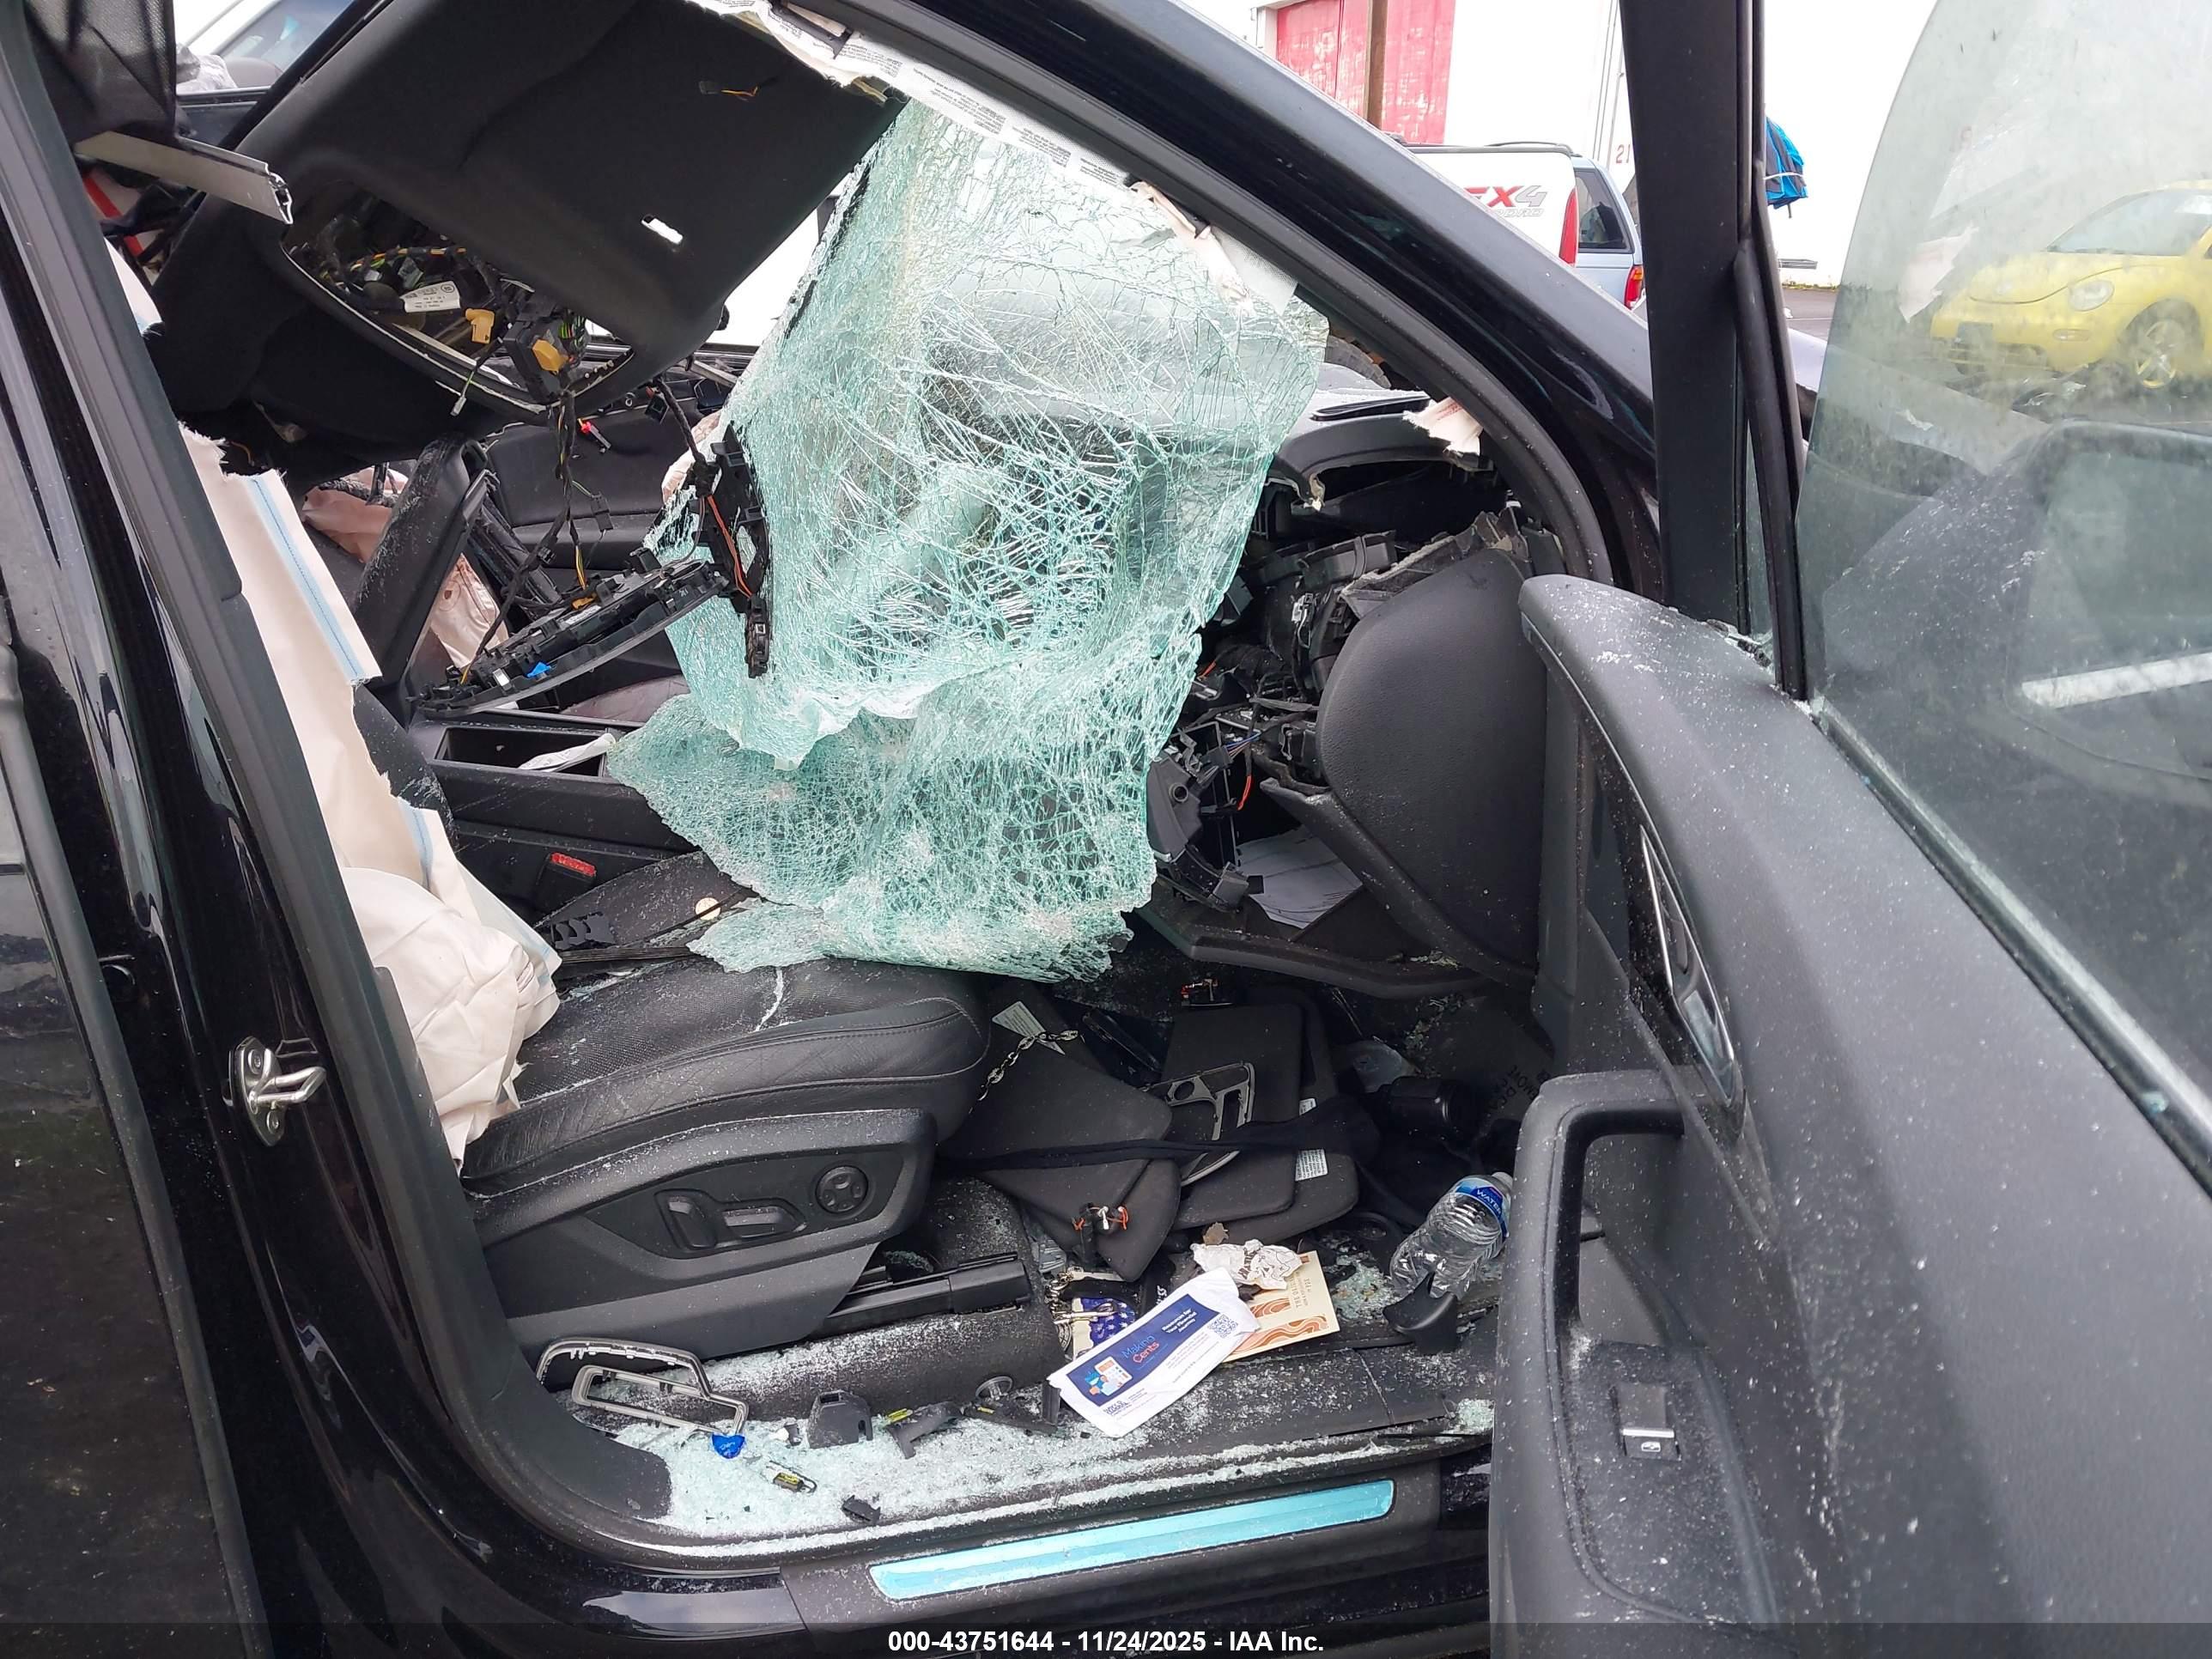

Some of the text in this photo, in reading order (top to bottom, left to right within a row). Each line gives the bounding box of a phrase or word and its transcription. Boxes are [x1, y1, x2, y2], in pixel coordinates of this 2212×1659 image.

[1477, 1188, 1501, 1215] WATER
[1121, 1334, 1155, 1358] Making
[1133, 1341, 1160, 1364] Cents
